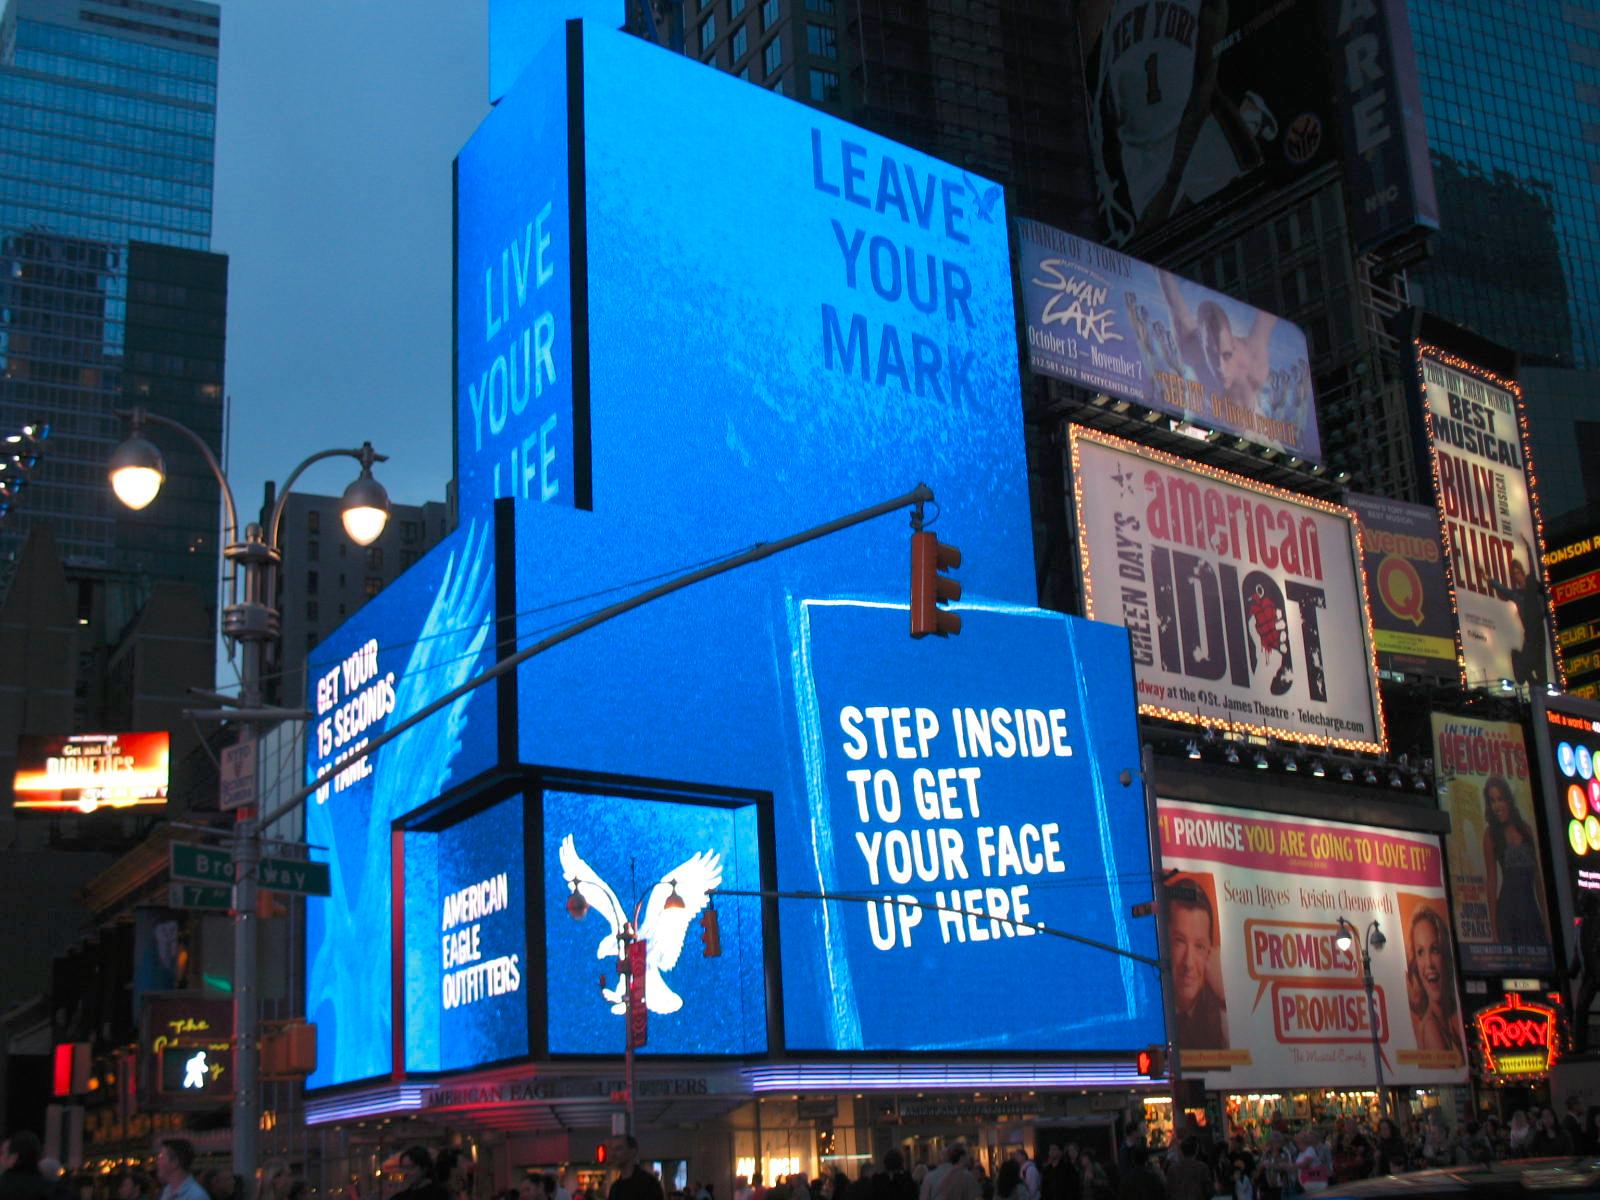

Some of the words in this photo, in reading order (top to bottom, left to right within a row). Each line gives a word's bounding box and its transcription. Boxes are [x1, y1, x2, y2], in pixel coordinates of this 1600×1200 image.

[811, 127, 970, 244] LEAVE
[486, 201, 554, 342] LIVE
[831, 218, 976, 328] YOUR
[1032, 258, 1108, 307] SWAN
[1042, 293, 1124, 344] LAKE
[821, 303, 985, 412] MARK
[1028, 325, 1066, 353] October
[1091, 345, 1137, 377] November
[469, 311, 557, 452] YOUR
[1431, 411, 1522, 470] MUSICAL
[1447, 392, 1496, 434] BEST
[1438, 450, 1499, 532] BILLY
[1114, 511, 1146, 583] DAY'S
[1144, 470, 1324, 581] american
[1448, 520, 1514, 602] ELLIOT
[1556, 575, 1598, 601] FOREX
[1377, 554, 1425, 627] Q
[1150, 543, 1328, 702] IDIOT
[317, 666, 341, 715] GET
[343, 638, 378, 695] YOUR
[317, 717, 333, 760] 15
[334, 672, 396, 748] SECONDS
[840, 706, 940, 760] STEP
[952, 707, 1073, 759] INSIDE
[1167, 686, 1178, 699] at
[1179, 687, 1196, 703] the
[1222, 695, 1254, 714] James
[1253, 700, 1289, 720] Theatre
[1297, 709, 1364, 734] Telecharge.com
[1462, 725, 1484, 737] THE
[1439, 732, 1529, 781] HEIGHTS
[846, 768, 902, 823] TO
[913, 767, 981, 821] GET
[195, 853, 305, 889] Broway
[855, 828, 969, 885] YOUR
[977, 822, 1066, 877] FACE
[1174, 817, 1244, 851] PROMISE
[1244, 825, 1275, 853] YOU
[1279, 830, 1308, 858] ARE
[1310, 833, 1353, 862] GOING
[1354, 838, 1372, 863] TO
[1375, 840, 1407, 871] LOVE
[190, 887, 202, 904] 7
[442, 872, 508, 932] AMERICAN
[867, 894, 923, 951] UP
[935, 885, 1046, 944] HERE.
[1223, 879, 1253, 906] Sean
[1256, 884, 1291, 913] Hayes
[1300, 887, 1335, 911] Kristin
[1338, 890, 1393, 915] Chenoweth
[442, 924, 481, 970] EAGLE
[443, 953, 521, 1010] OUTFITTERS
[1484, 1015, 1548, 1048] ROXY
